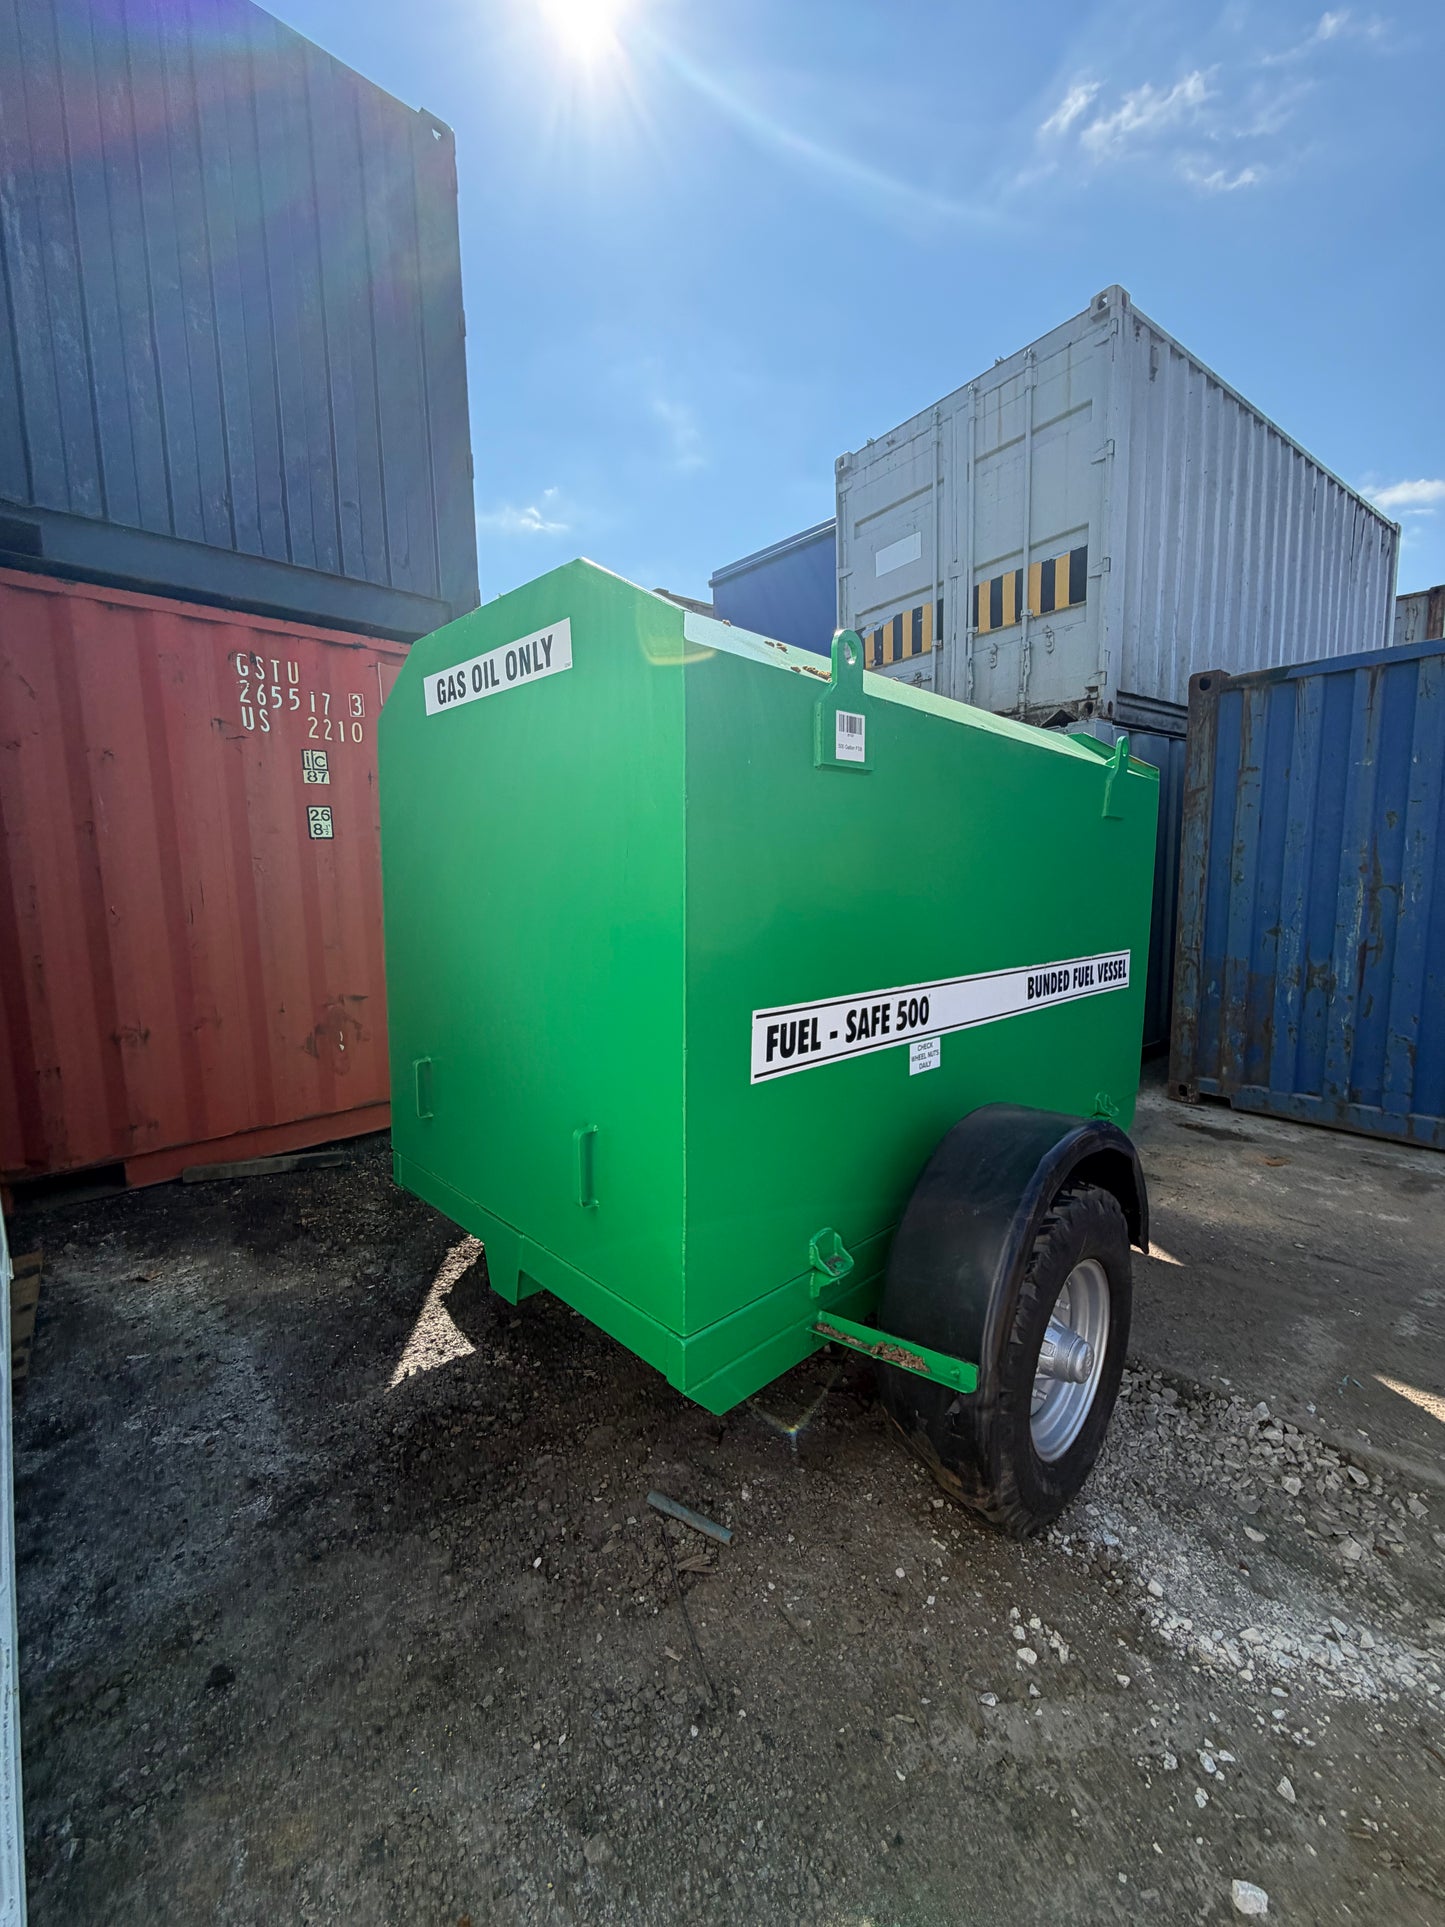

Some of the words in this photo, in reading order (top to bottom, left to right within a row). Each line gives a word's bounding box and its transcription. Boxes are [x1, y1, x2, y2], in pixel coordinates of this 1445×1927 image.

[236, 653, 299, 685] GSTU
[436, 670, 467, 706] GAS
[471, 658, 500, 693] OIL
[505, 634, 553, 682] ONLY
[351, 695, 363, 717] 3
[241, 706, 270, 733] US
[307, 716, 363, 743] 2210
[306, 770, 328, 784] 87
[1027, 969, 1070, 1000] BUNDED
[1073, 965, 1095, 990] FUEL
[1097, 959, 1127, 983] VESSEL
[765, 1017, 821, 1063] FUEL
[829, 1030, 838, 1040] -
[845, 1003, 890, 1044] SAFE
[896, 995, 930, 1032] 500
[911, 1052, 927, 1063] WHEEL
[927, 1049, 940, 1058] NUTS
[917, 1041, 934, 1052] CHECK
[918, 1060, 932, 1070] DAILY
